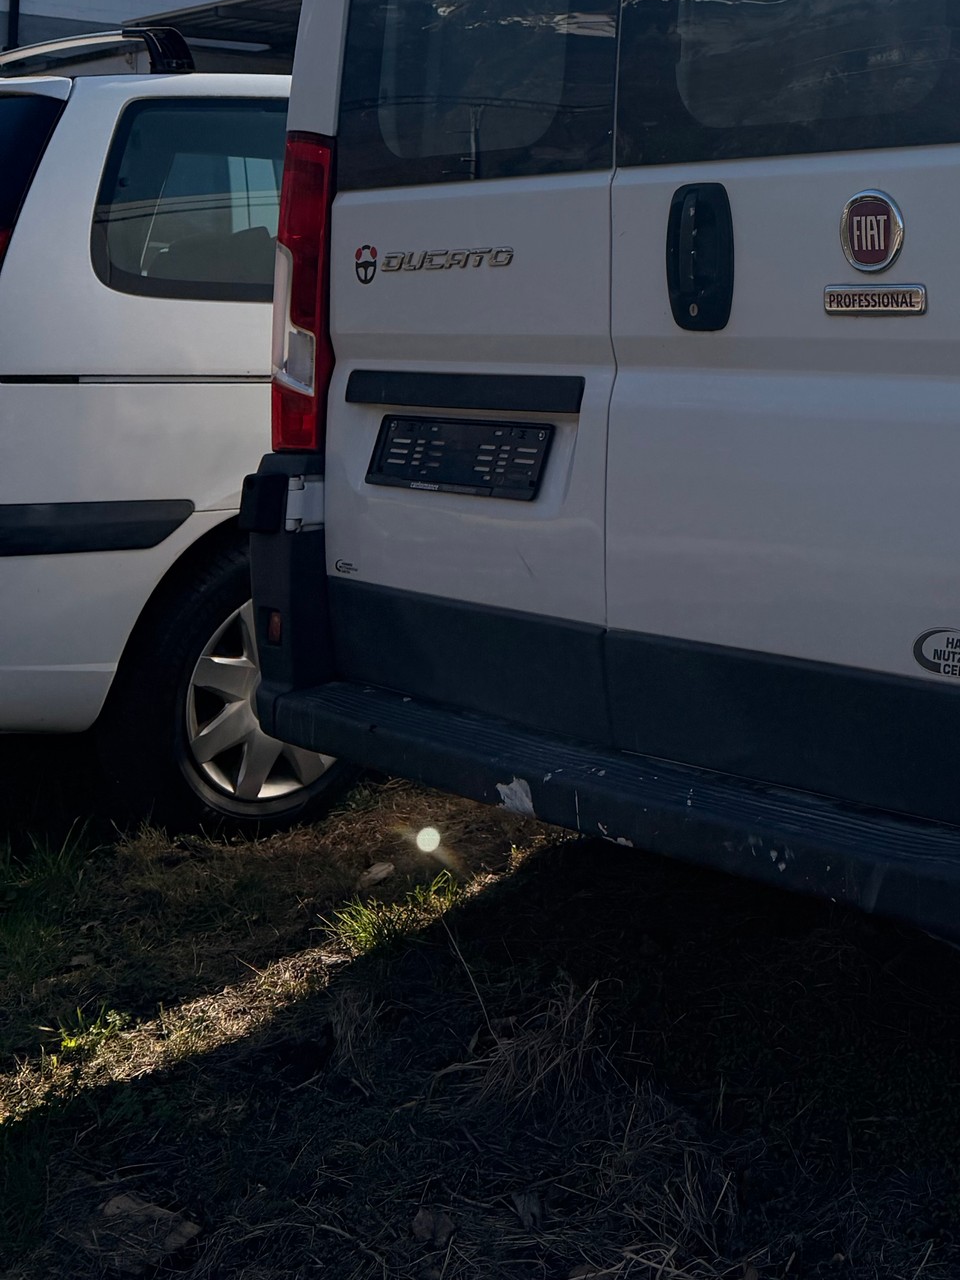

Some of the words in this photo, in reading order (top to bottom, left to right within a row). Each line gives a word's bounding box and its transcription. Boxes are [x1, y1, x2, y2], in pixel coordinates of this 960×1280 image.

[852, 215, 888, 251] FIAT
[381, 245, 514, 272] DUCATO
[828, 293, 916, 308] PROFESSIONAL
